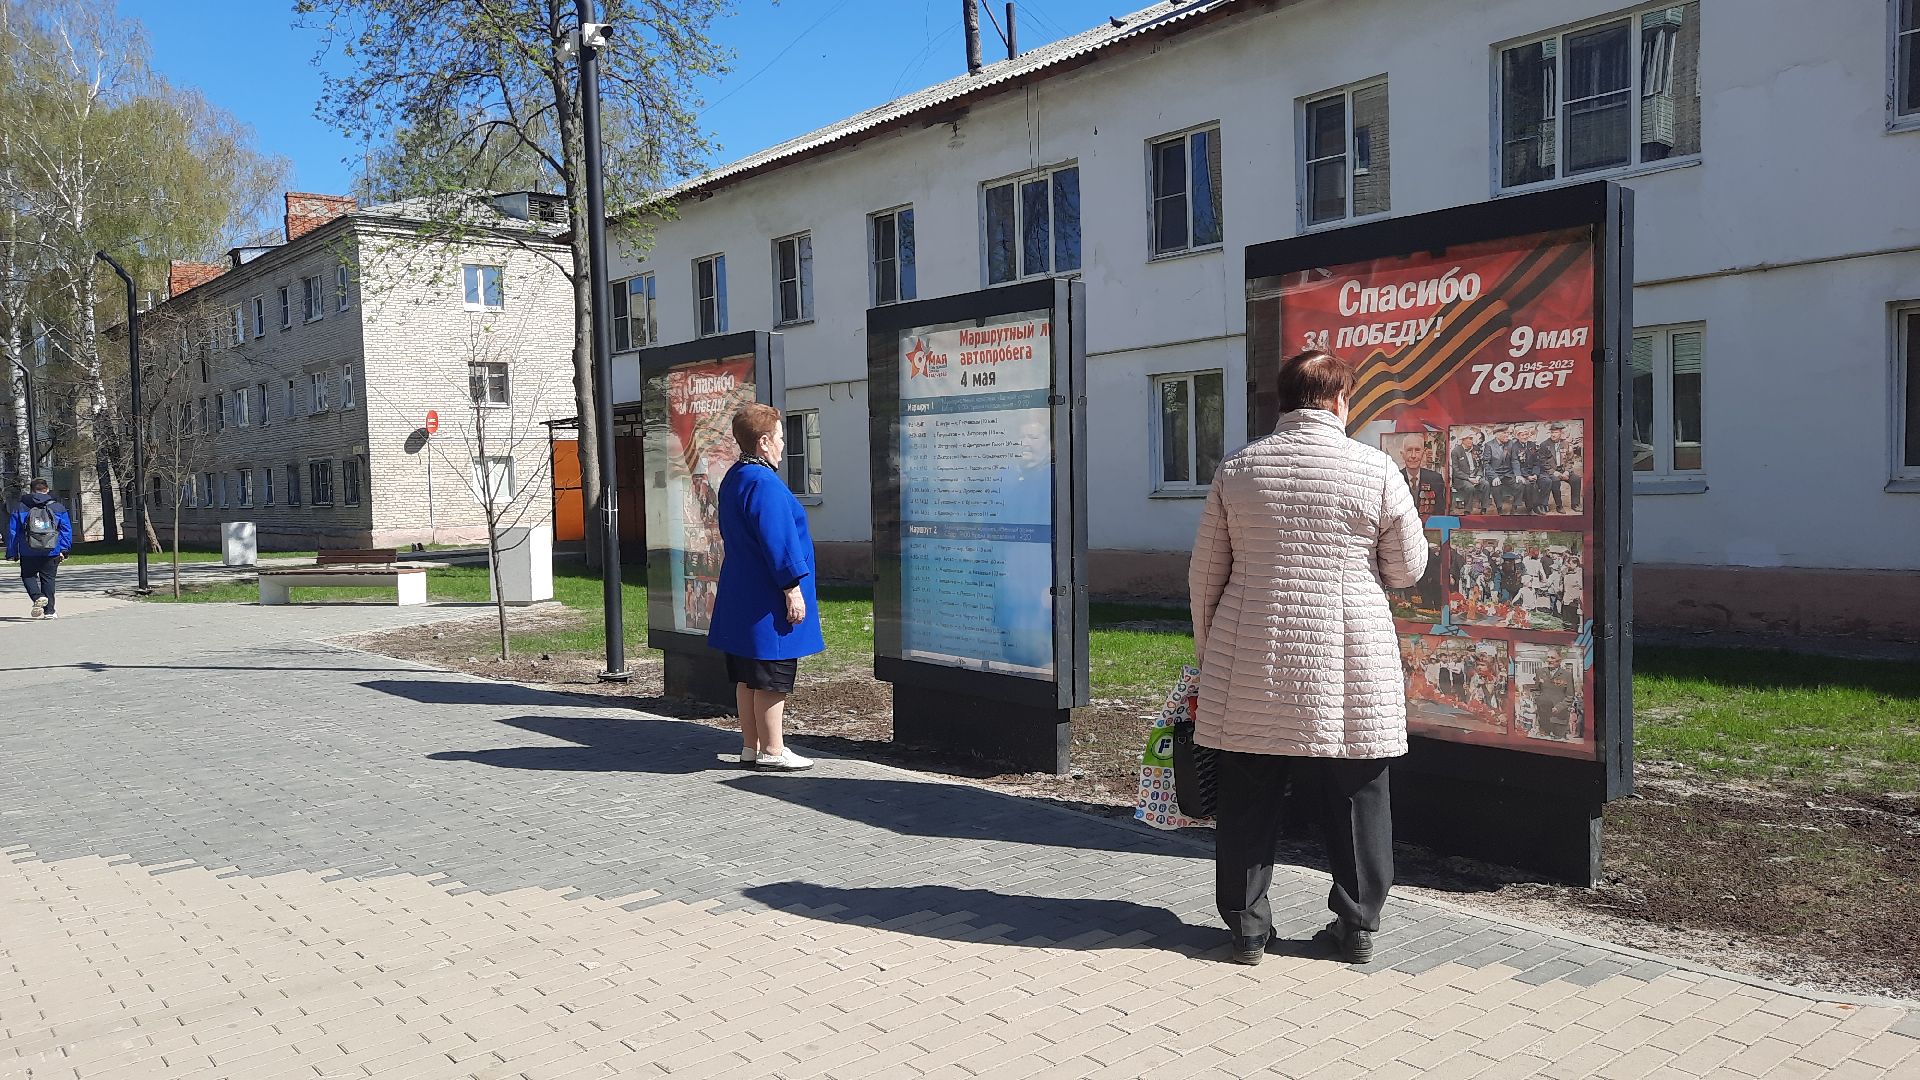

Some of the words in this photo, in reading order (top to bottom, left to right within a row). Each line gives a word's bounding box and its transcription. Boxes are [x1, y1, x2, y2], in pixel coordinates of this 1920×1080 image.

[1338, 266, 1481, 317] Спасибо
[960, 322, 1034, 347] Маршрутный
[1301, 330, 1329, 351] ЗА
[1335, 316, 1443, 348] ПОБЕДУ!
[1508, 325, 1534, 358] 9
[1535, 326, 1588, 351] МАЯ
[928, 353, 948, 366] МАЯ
[960, 344, 1032, 366] автопробега
[687, 371, 735, 396] Спасибо
[960, 371, 967, 388] 4
[972, 371, 996, 387] мая
[907, 403, 930, 413] Маршрут
[909, 525, 932, 535] Маршрут
[933, 525, 938, 535] 2
